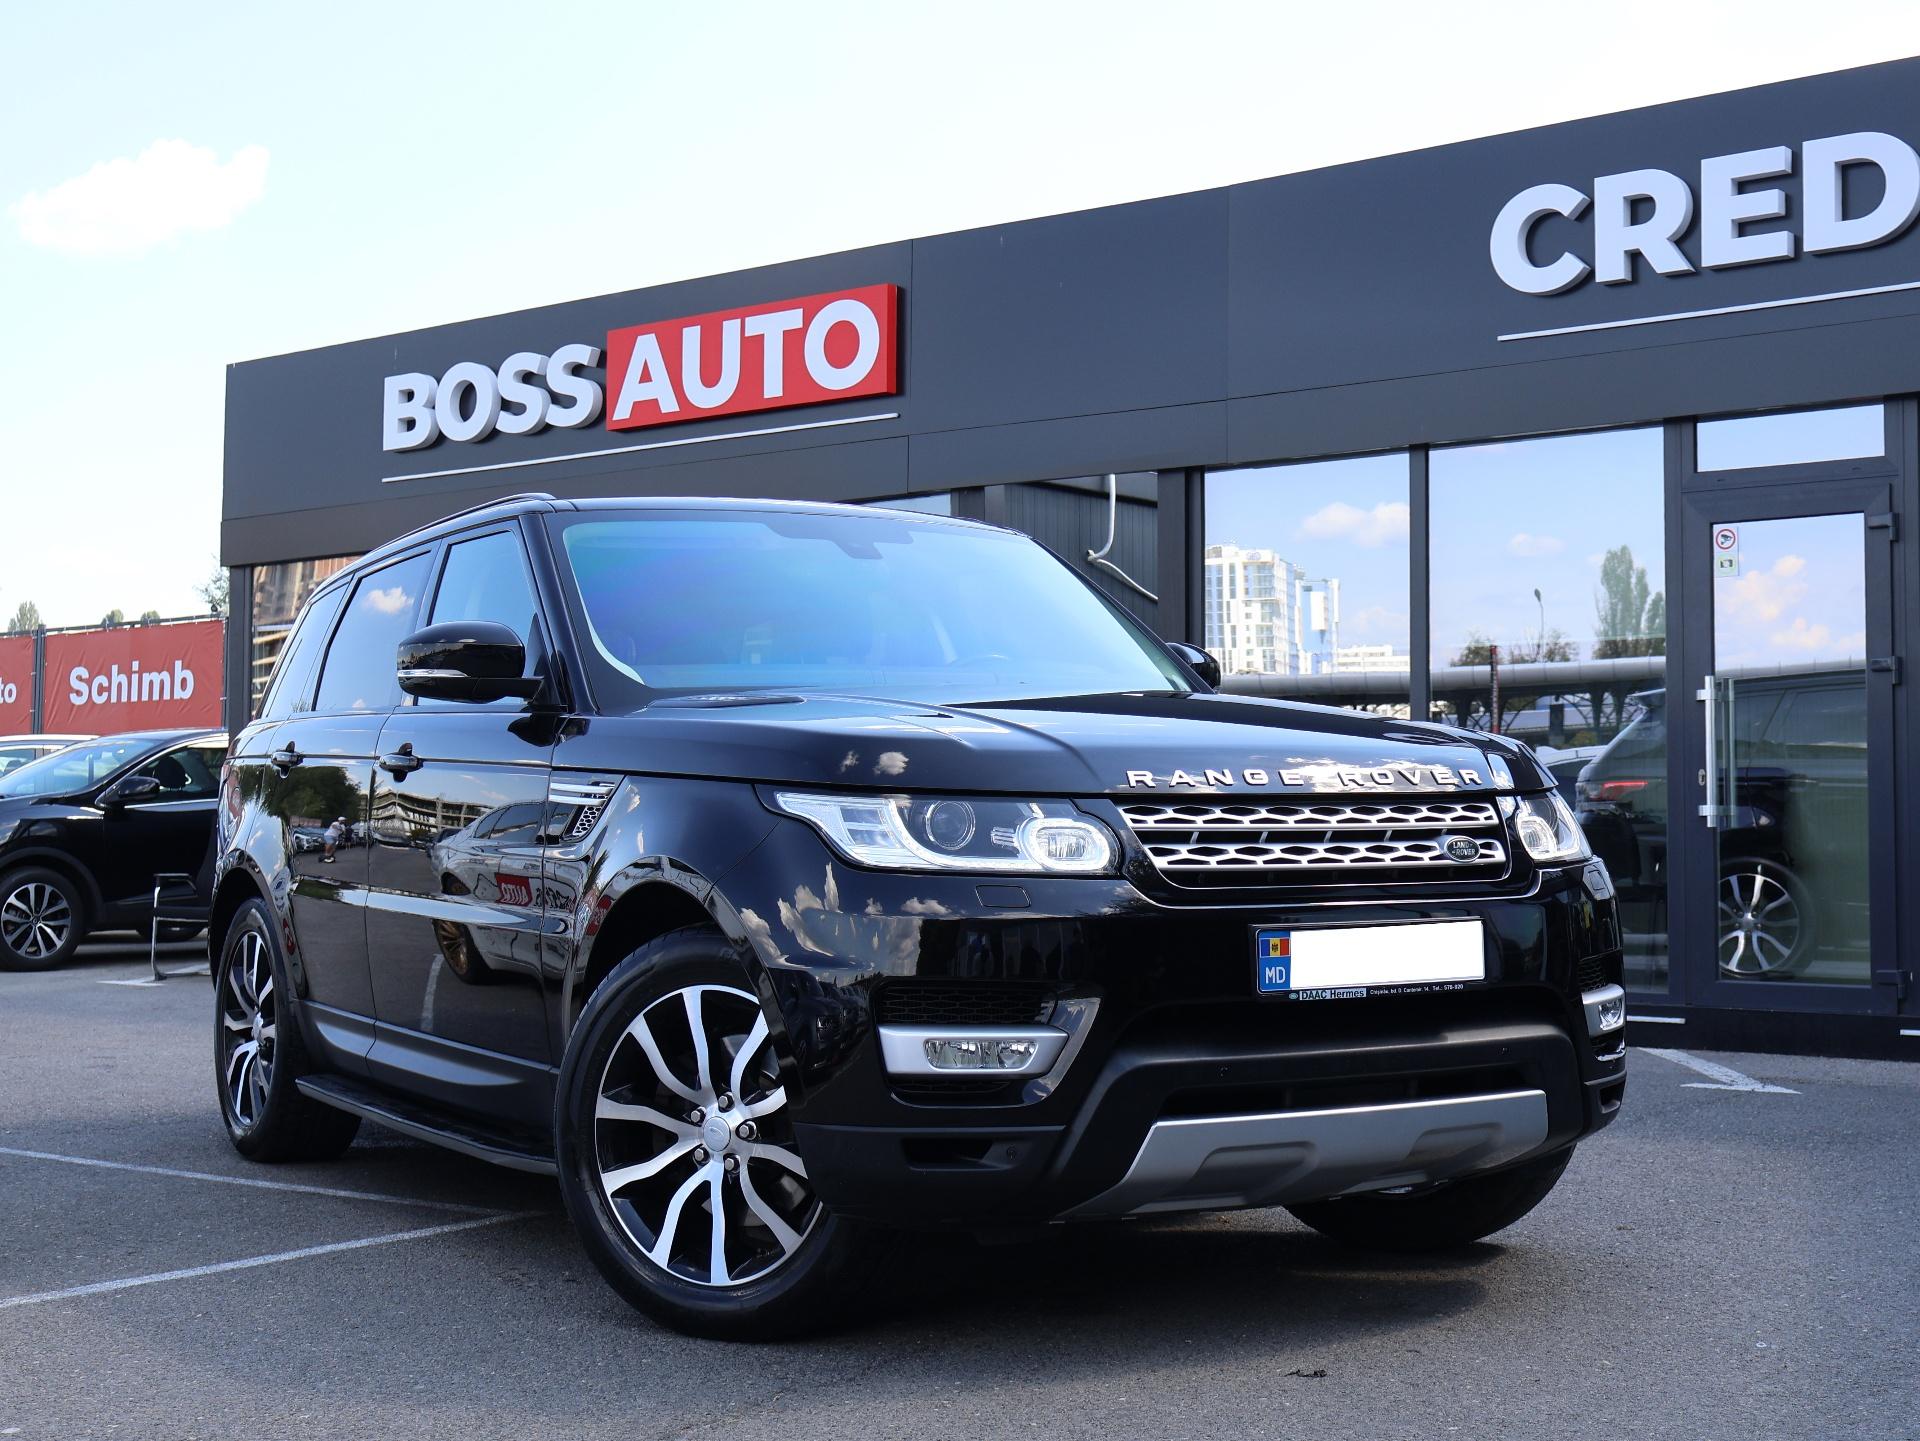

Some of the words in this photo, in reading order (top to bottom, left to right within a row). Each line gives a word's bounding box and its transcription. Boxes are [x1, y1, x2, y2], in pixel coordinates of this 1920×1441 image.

[1489, 131, 1920, 295] CRED
[382, 343, 603, 452] BOSS
[612, 299, 881, 421] AUTO
[69, 659, 195, 706] Schimb
[1126, 768, 1304, 788] RANGE
[1337, 768, 1483, 787] ROVER
[1452, 841, 1470, 849] LAND
[1455, 848, 1476, 856] ROVER
[1265, 966, 1286, 984] MD
[1301, 991, 1328, 1000] DAAC
[1330, 989, 1365, 999] Hermes
